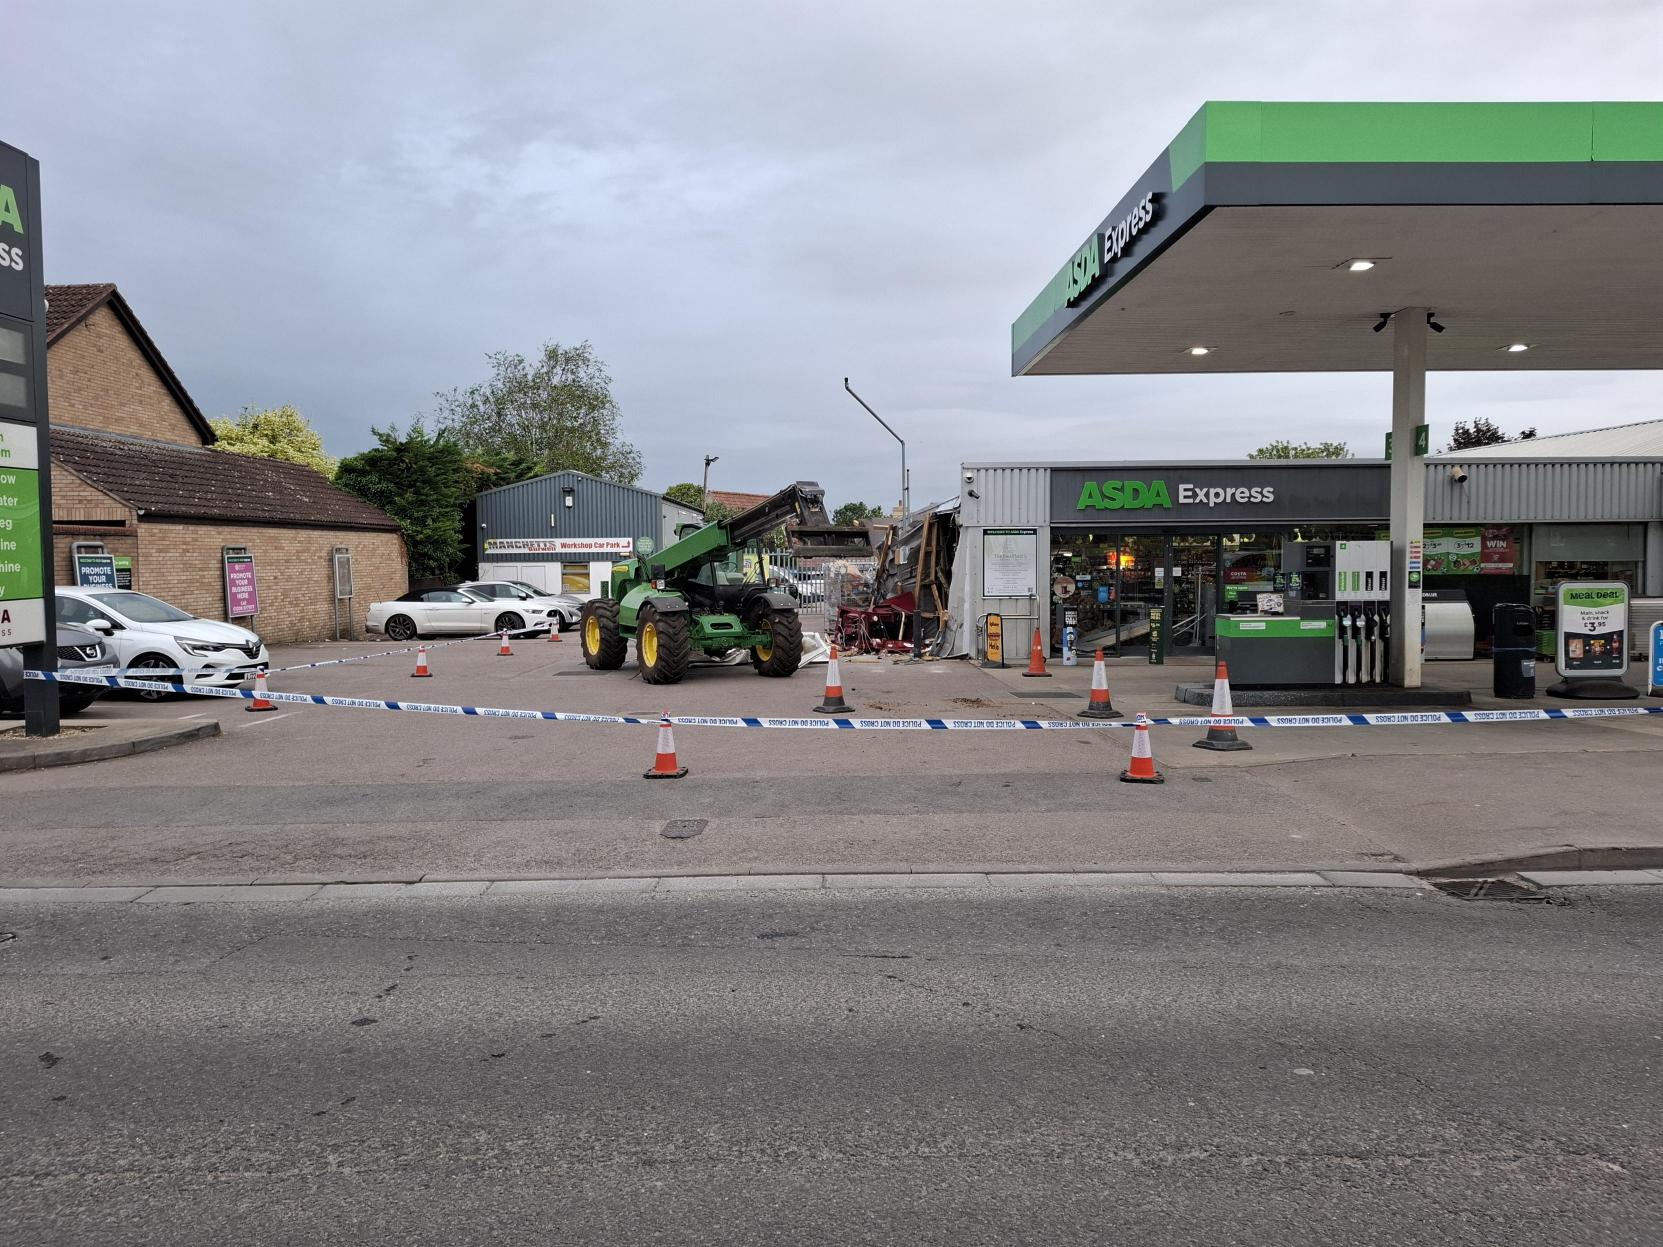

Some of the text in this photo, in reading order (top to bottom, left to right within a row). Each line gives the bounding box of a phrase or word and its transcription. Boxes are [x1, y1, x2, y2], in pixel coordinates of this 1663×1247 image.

[1064, 192, 1152, 308] ASDA Express
[1418, 432, 1426, 448] 4
[1076, 480, 1274, 510] ASDA Express
[1584, 622, 1606, 632] £3.95
[1474, 712, 1494, 720] CROSS
[1519, 711, 1539, 719] POLICE
